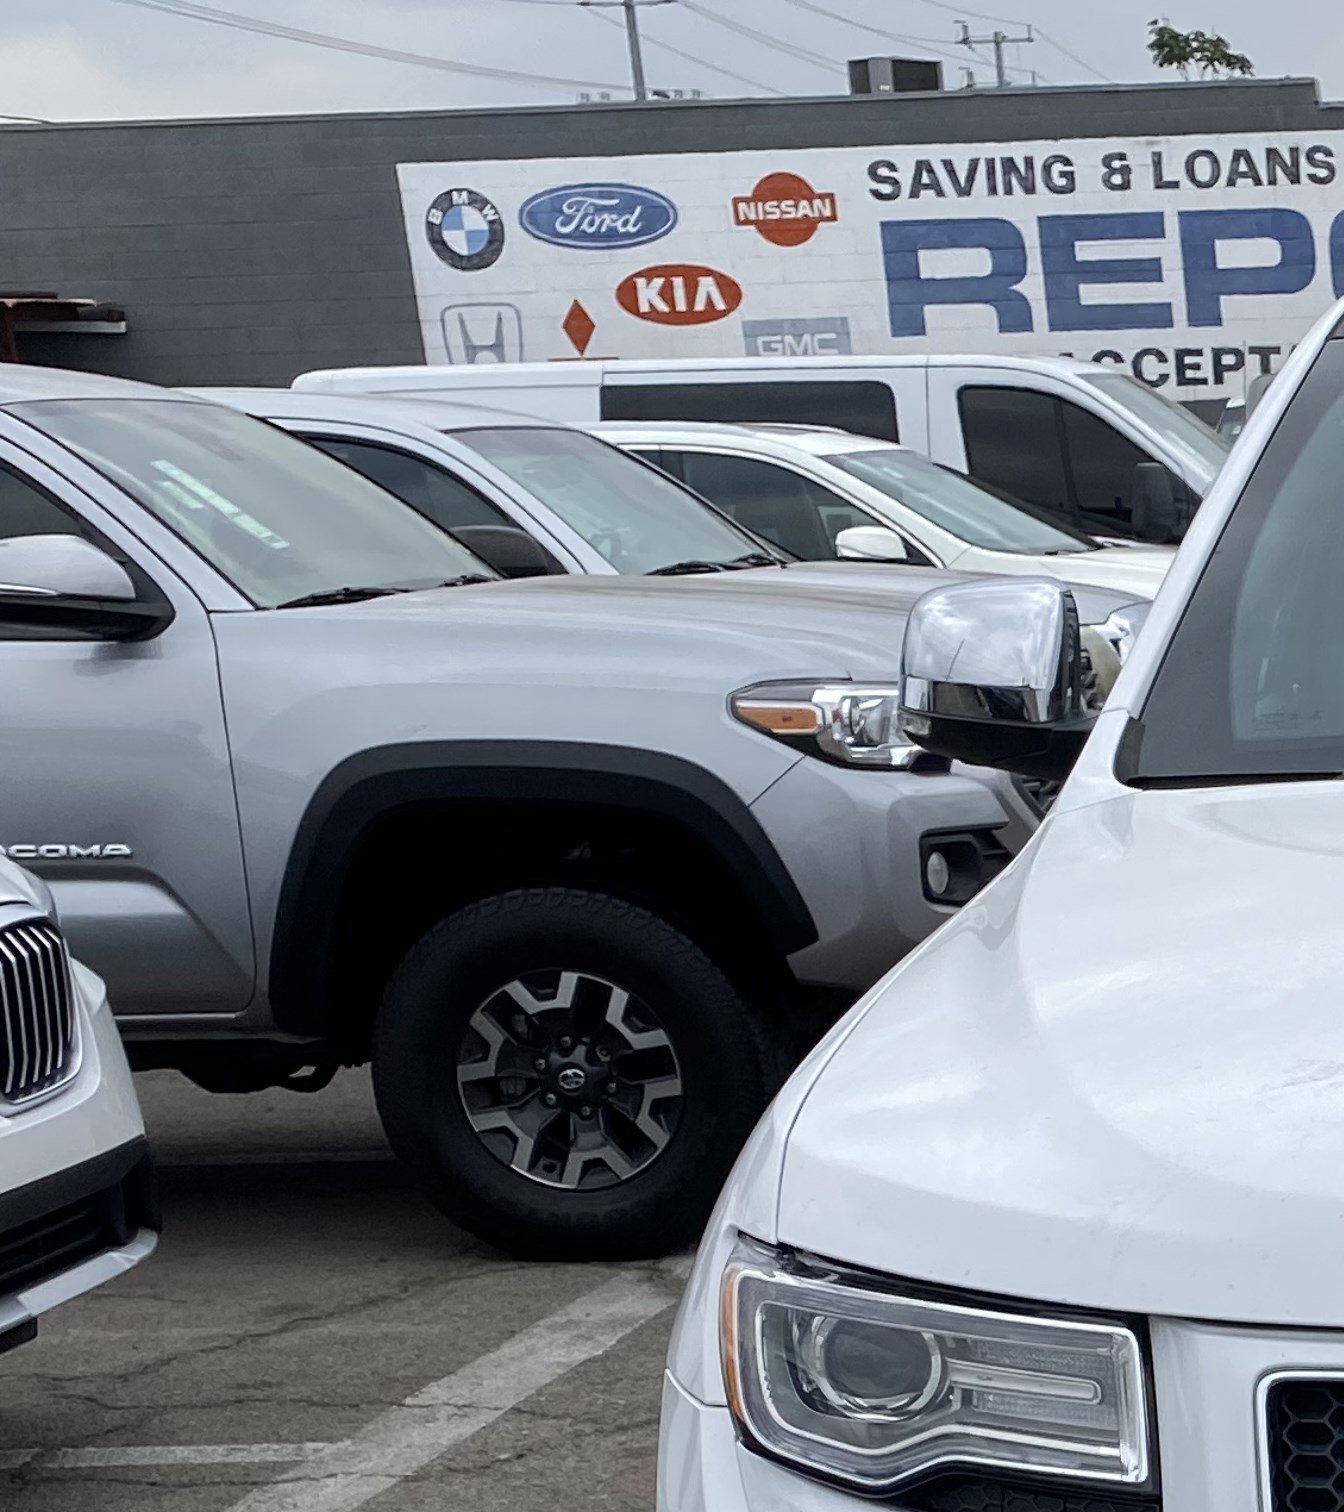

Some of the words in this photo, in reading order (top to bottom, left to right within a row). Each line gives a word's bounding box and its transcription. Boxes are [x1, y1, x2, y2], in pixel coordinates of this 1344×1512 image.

[867, 154, 1077, 201] SAVING
[1101, 153, 1132, 191] &
[1152, 144, 1336, 191] LOANS
[428, 190, 500, 226] BMW
[554, 195, 643, 235] Ford
[737, 197, 832, 221] NISSAN
[632, 275, 727, 314] KIA
[757, 332, 839, 356] GMC
